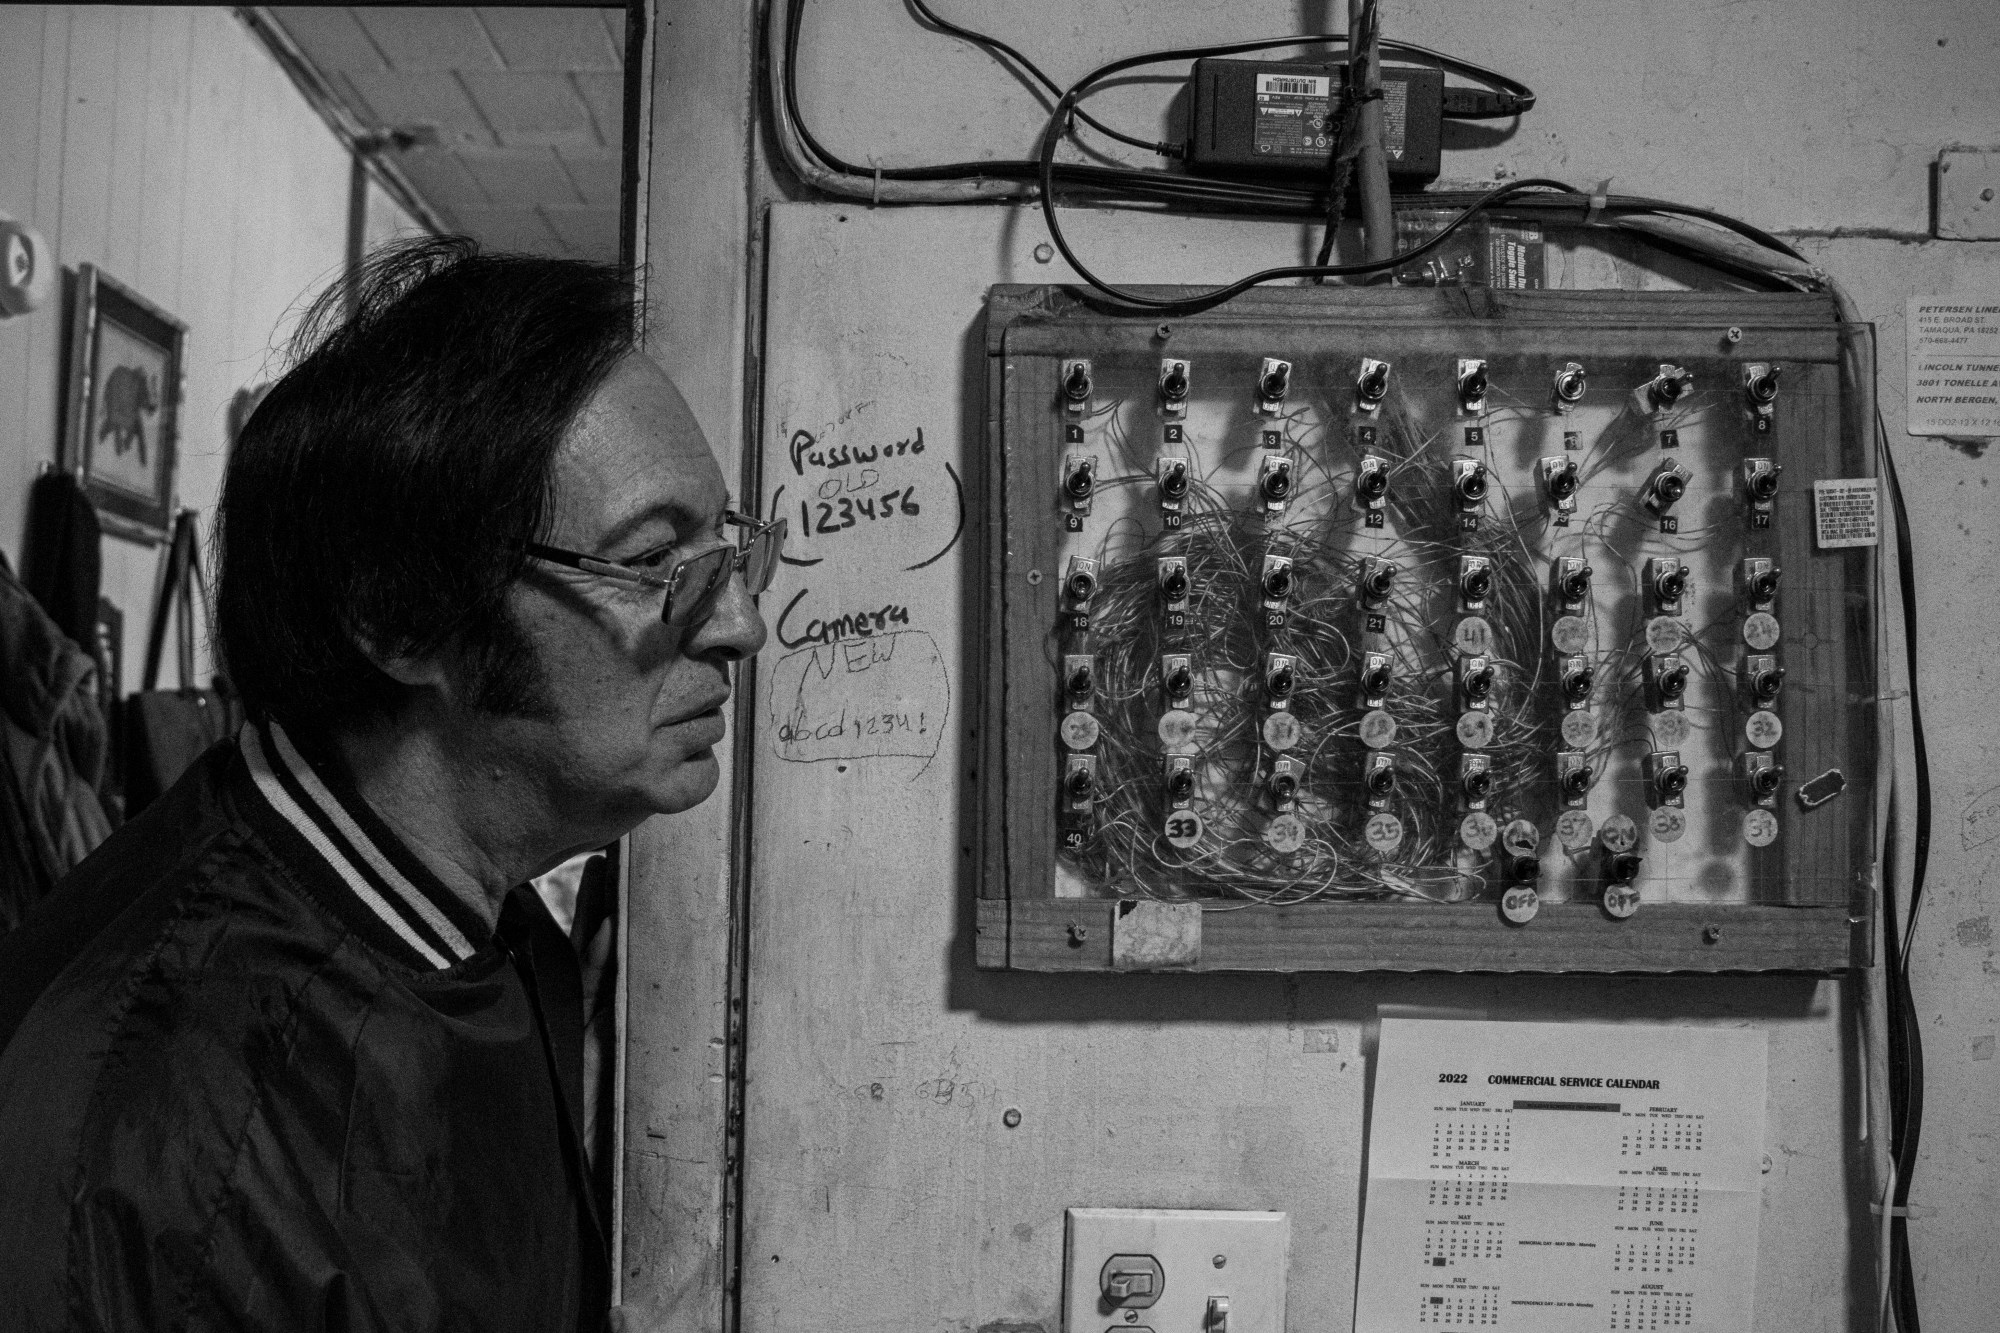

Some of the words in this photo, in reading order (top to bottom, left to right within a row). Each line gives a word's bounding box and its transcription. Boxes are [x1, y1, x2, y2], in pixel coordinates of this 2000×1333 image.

[1507, 242, 1516, 268] Toggle
[1517, 245, 1526, 276] Medium
[1517, 278, 1526, 290] Du
[1919, 306, 1974, 314] PETERSEN
[1975, 306, 2000, 314] LINE
[1918, 364, 1964, 372] LINCOLN
[1954, 396, 1998, 405] BERGEN,
[1758, 420, 1766, 430] 8
[1170, 428, 1178, 438] 2
[1364, 430, 1372, 440] 4
[1471, 432, 1478, 441] 5
[1269, 435, 1276, 444] 3
[1666, 434, 1673, 444] 7
[790, 426, 925, 476] Password
[818, 468, 880, 499] OLD
[802, 486, 920, 538] 123456
[1070, 518, 1078, 528] 9
[1166, 516, 1180, 525] 10
[1369, 514, 1382, 524] 12
[1462, 518, 1476, 528] 14
[1756, 514, 1768, 524] 17
[1663, 520, 1676, 530] 16
[776, 588, 910, 650] Camera
[1073, 618, 1088, 628] 18
[1170, 616, 1183, 626] 19
[1268, 615, 1284, 626] 20
[1369, 618, 1382, 628] 21
[801, 633, 896, 688] NEW
[1166, 819, 1196, 838] 33
[1654, 814, 1681, 834] 38
[1370, 822, 1400, 841] 35
[1066, 834, 1082, 844] 40
[1505, 893, 1536, 910] OFF
[1438, 1073, 1468, 1084] 2022
[1488, 1074, 1557, 1086] COMMERCIAL
[1560, 1076, 1604, 1088] SERVICE
[1606, 1078, 1660, 1090] CALENDAR
